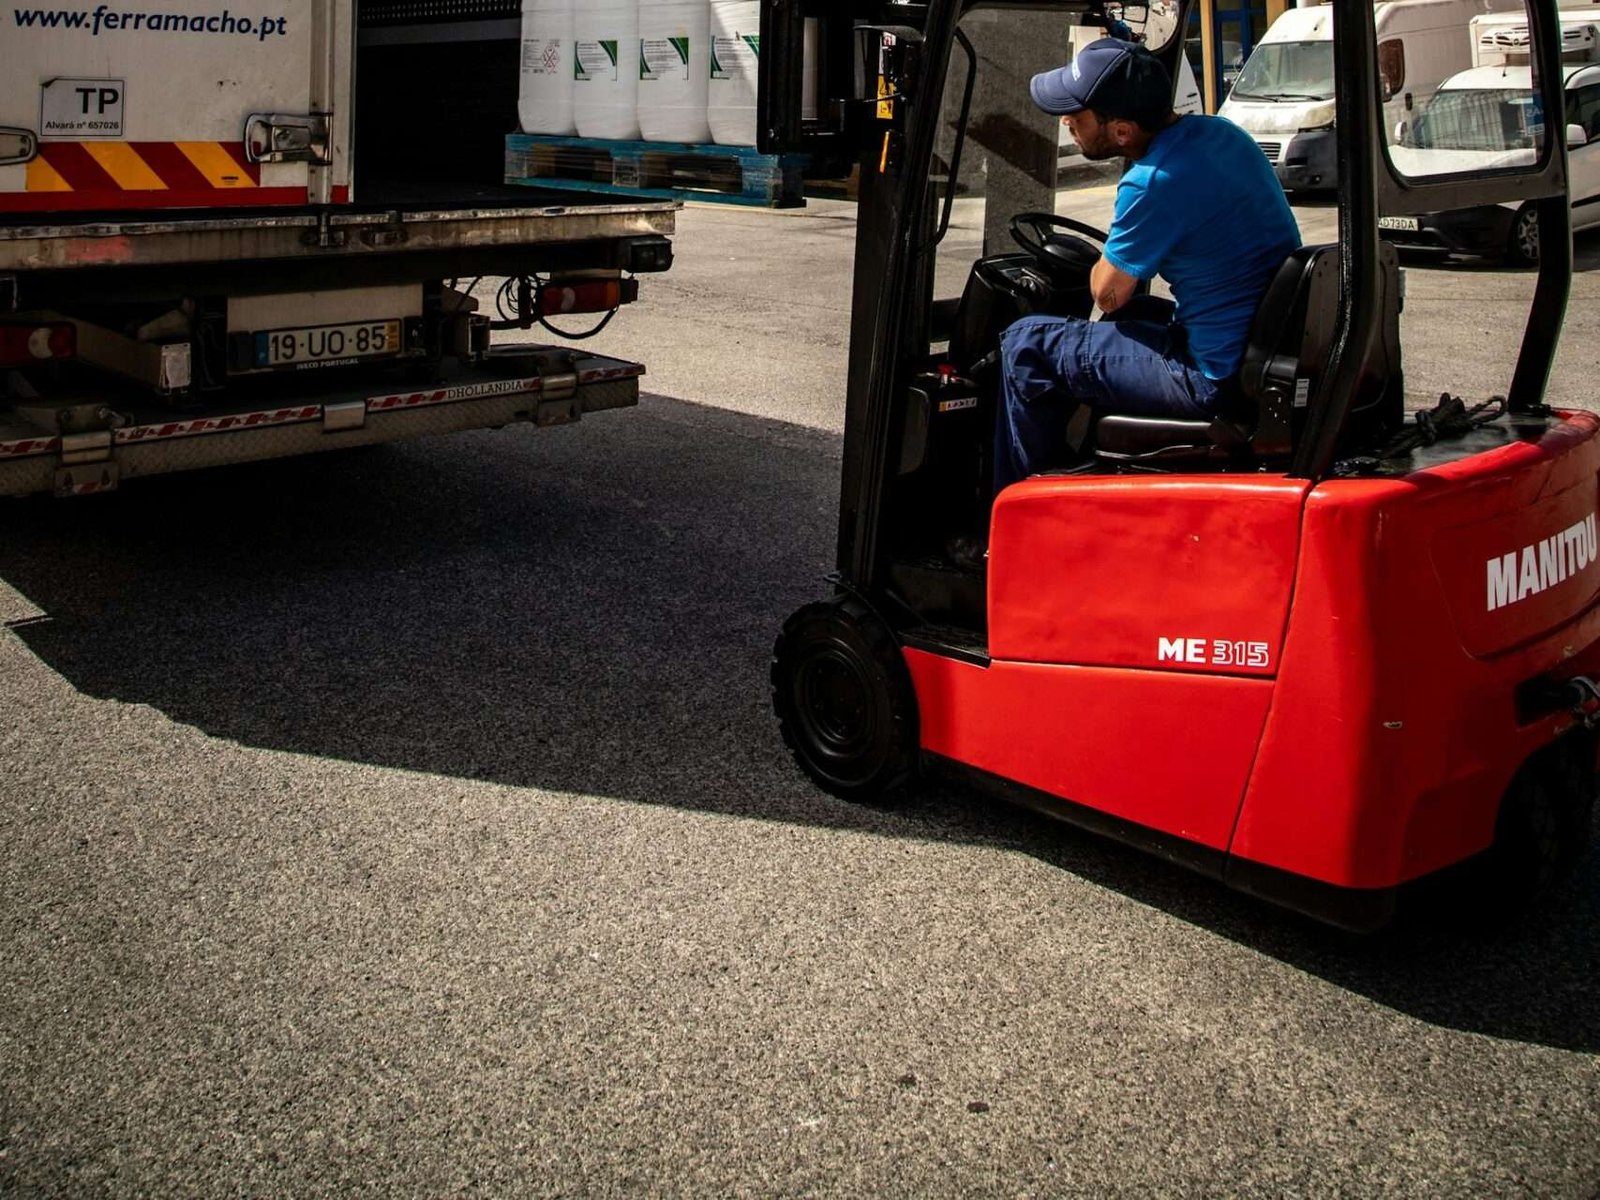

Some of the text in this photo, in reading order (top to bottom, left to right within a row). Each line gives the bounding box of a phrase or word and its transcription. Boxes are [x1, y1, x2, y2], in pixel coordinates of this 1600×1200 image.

[14, 5, 287, 41] www.ferramacho.pt
[75, 87, 119, 114] TP
[45, 119, 75, 130] Alvará
[88, 120, 119, 130] 657026
[296, 358, 360, 371] IVECO PORTUGAL
[447, 380, 524, 400] DHOLLANDIA
[1487, 512, 1597, 612] MANITOU
[1158, 637, 1269, 667] ME 315
